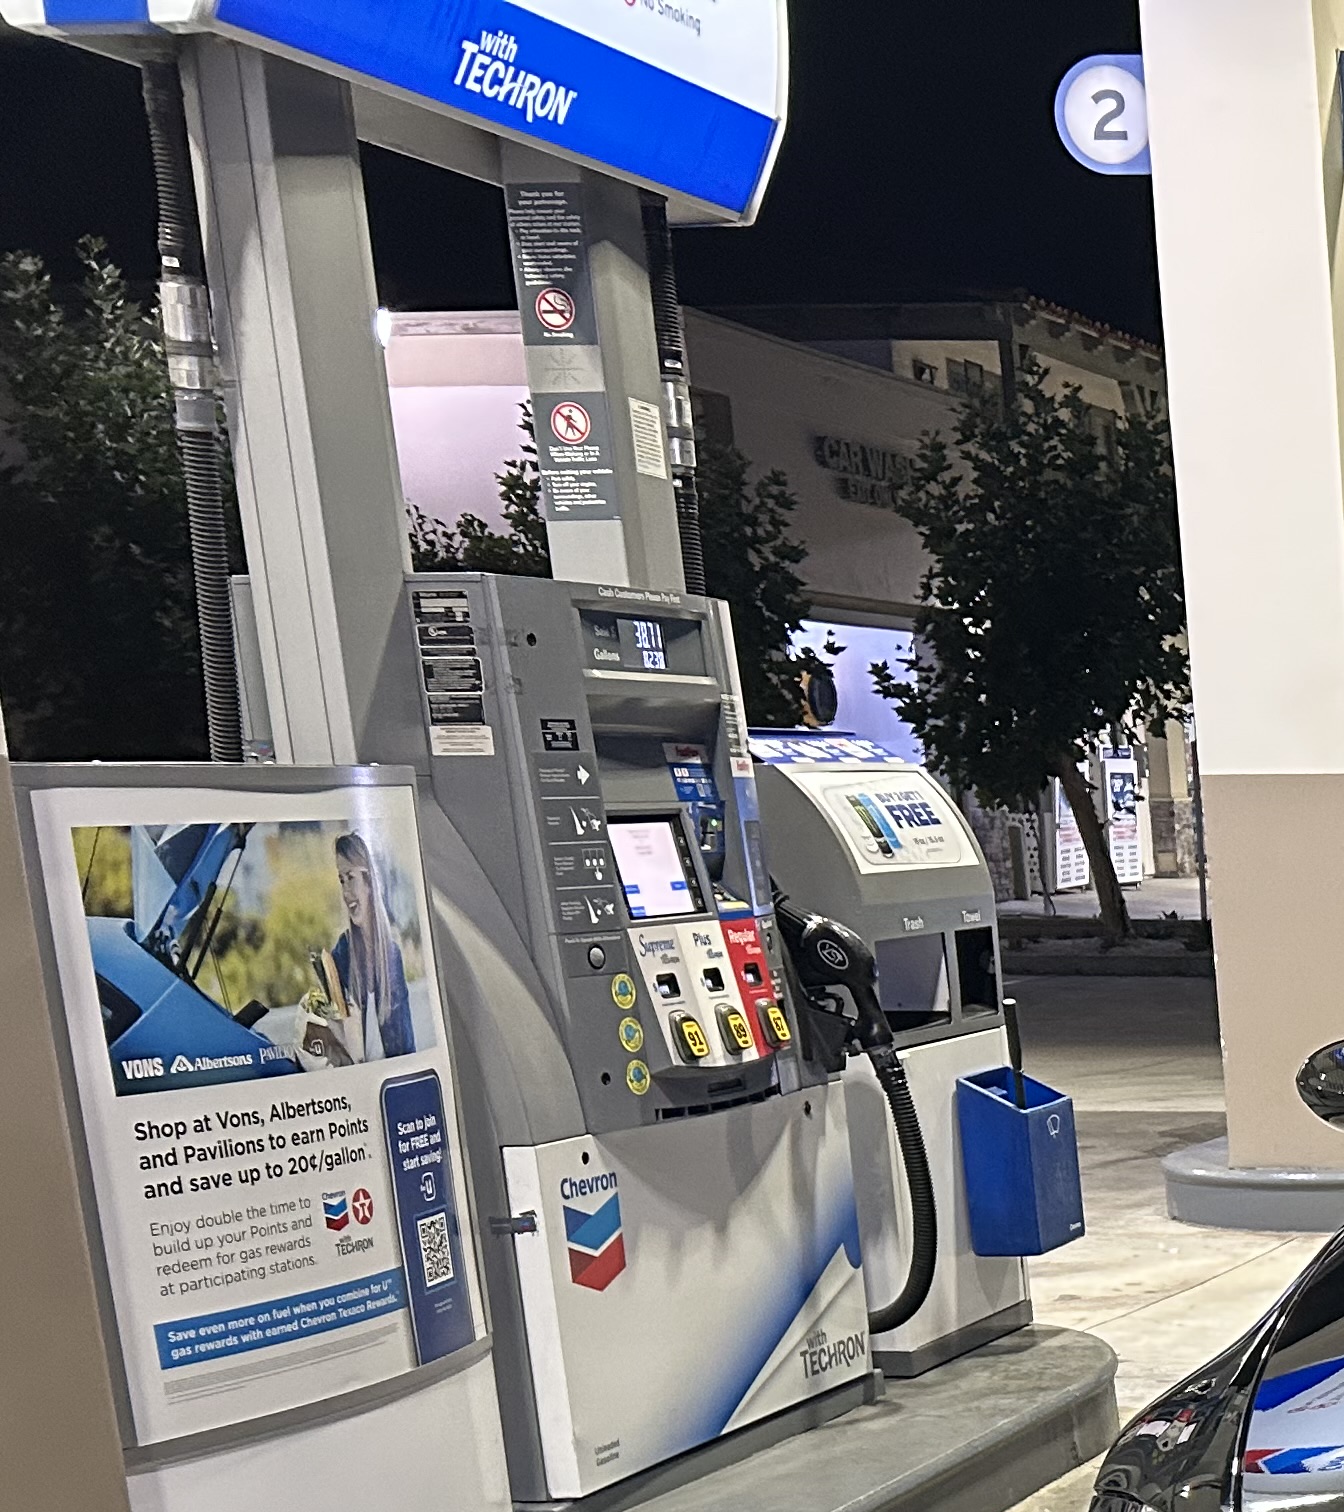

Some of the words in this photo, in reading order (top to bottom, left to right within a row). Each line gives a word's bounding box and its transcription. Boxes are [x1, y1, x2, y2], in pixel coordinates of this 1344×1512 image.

[658, 0, 701, 37] Smoking
[480, 30, 518, 62] with
[453, 40, 577, 125] TECHRON
[1090, 88, 1128, 141] 2
[593, 648, 620, 661] Gallons
[884, 802, 943, 829] FREE
[903, 916, 925, 931] Trash
[962, 909, 981, 923] Towel
[639, 934, 676, 957] Supreme
[692, 932, 712, 947] Plus
[727, 928, 756, 946] Regular
[688, 1031, 703, 1047] 91
[733, 1023, 748, 1039] 89
[121, 1056, 164, 1079] VONS
[193, 1054, 252, 1072] Albertsons
[134, 1120, 187, 1142] Shop
[193, 1115, 212, 1134] at
[215, 1109, 266, 1130] Vons,
[269, 1095, 352, 1122] Albertsons,
[397, 1122, 415, 1135] Scan
[415, 1118, 424, 1131] to
[423, 1113, 437, 1131] join
[139, 1147, 178, 1170] and
[183, 1137, 265, 1164] Pavilions
[268, 1133, 287, 1150] to
[291, 1127, 326, 1146] earn
[328, 1116, 370, 1140] Points
[398, 1139, 410, 1154] for
[410, 1133, 430, 1151] FREE
[429, 1129, 441, 1145] and
[402, 1154, 420, 1171] start
[143, 1175, 184, 1199] and
[189, 1170, 233, 1192] save
[237, 1166, 261, 1186] up
[265, 1162, 284, 1179] to
[560, 1171, 618, 1200] Chevron
[321, 1190, 346, 1200] Chevron
[150, 1219, 191, 1238] Enjoy
[195, 1209, 243, 1230] double
[246, 1205, 268, 1220] the
[270, 1200, 297, 1216] time
[298, 1196, 312, 1209] to
[152, 1237, 192, 1257] build
[194, 1236, 214, 1251] up
[216, 1231, 247, 1250] your
[249, 1221, 289, 1240] Points
[291, 1214, 313, 1230] and
[335, 1236, 374, 1257] TECHRON
[156, 1252, 213, 1277] redeem
[216, 1249, 236, 1265] for
[239, 1247, 263, 1264] gas
[265, 1235, 312, 1256] rewards
[160, 1283, 176, 1297] at
[179, 1265, 266, 1296] participating
[269, 1255, 317, 1274] stations.
[167, 1329, 196, 1343] Save
[198, 1323, 226, 1337] even
[227, 1317, 256, 1330] more
[257, 1312, 271, 1324] on
[272, 1305, 292, 1320] fuel
[292, 1301, 318, 1315] when
[318, 1297, 336, 1311] you
[336, 1286, 370, 1304] combine
[370, 1282, 382, 1294] for
[171, 1347, 193, 1361] gas
[194, 1335, 239, 1354] rewards
[240, 1328, 264, 1344] with
[265, 1320, 299, 1337] earned
[300, 1312, 337, 1329] Chevron
[338, 1304, 366, 1318] Texaco
[806, 1328, 828, 1350] with
[799, 1331, 866, 1379] TECHRON
